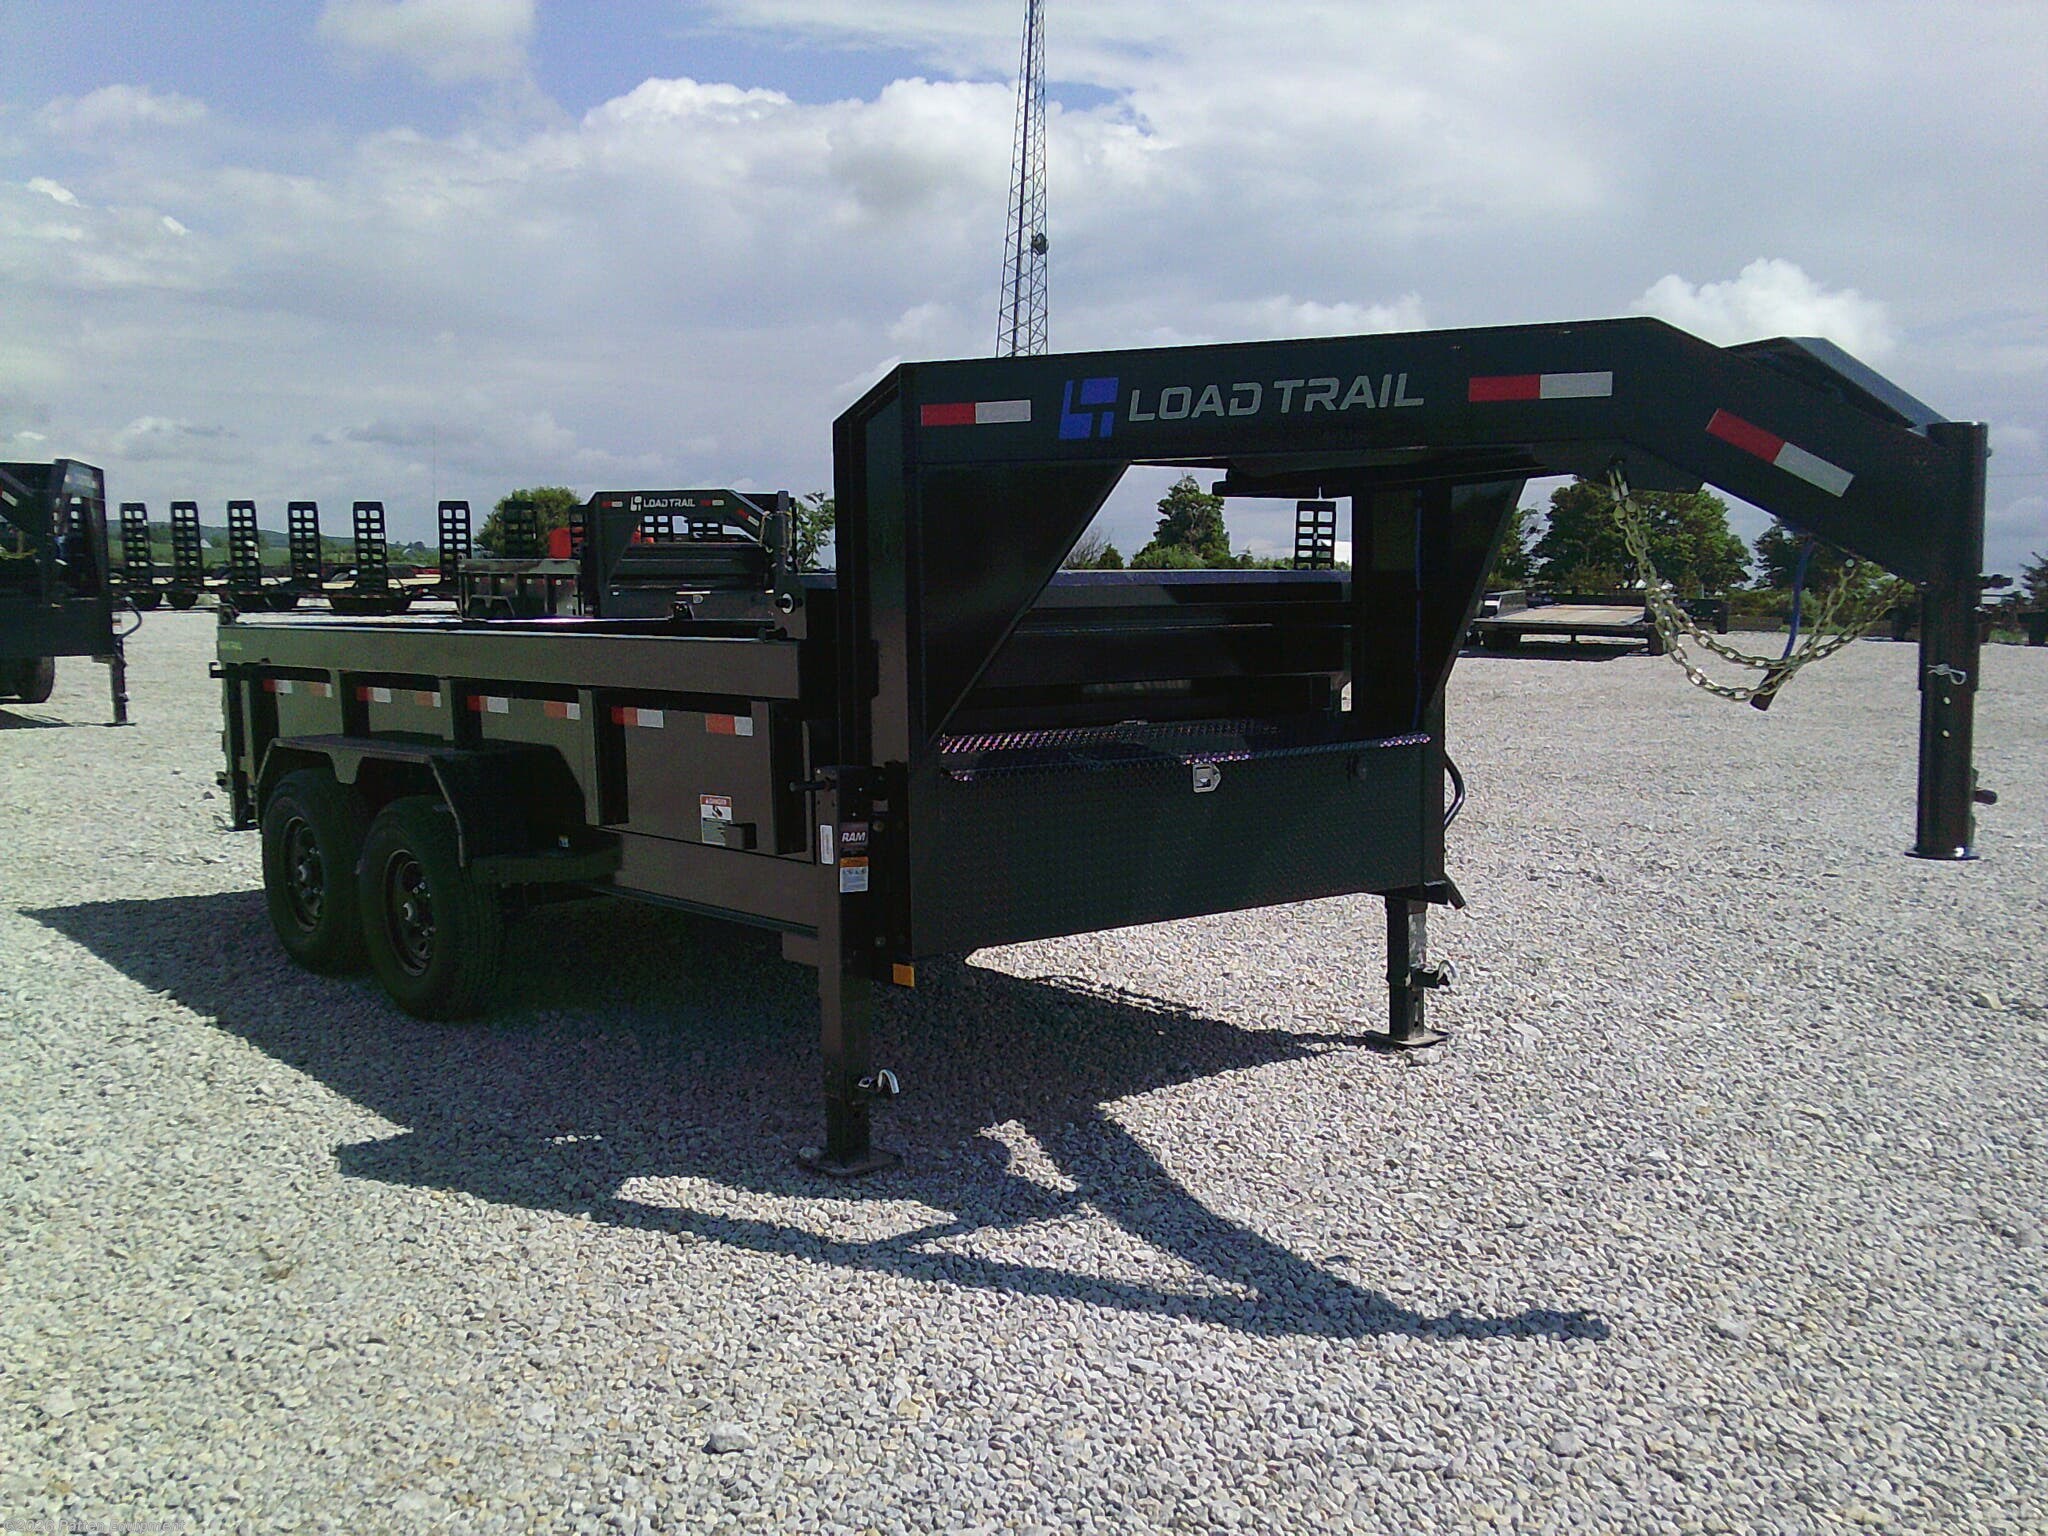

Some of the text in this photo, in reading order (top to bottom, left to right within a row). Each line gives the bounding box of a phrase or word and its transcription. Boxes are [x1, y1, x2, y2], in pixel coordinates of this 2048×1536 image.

[1129, 382, 1262, 421] LOAD
[1274, 373, 1424, 413] TRAIL
[643, 498, 696, 508] LOAD TRAIL
[841, 832, 866, 842] RAM
